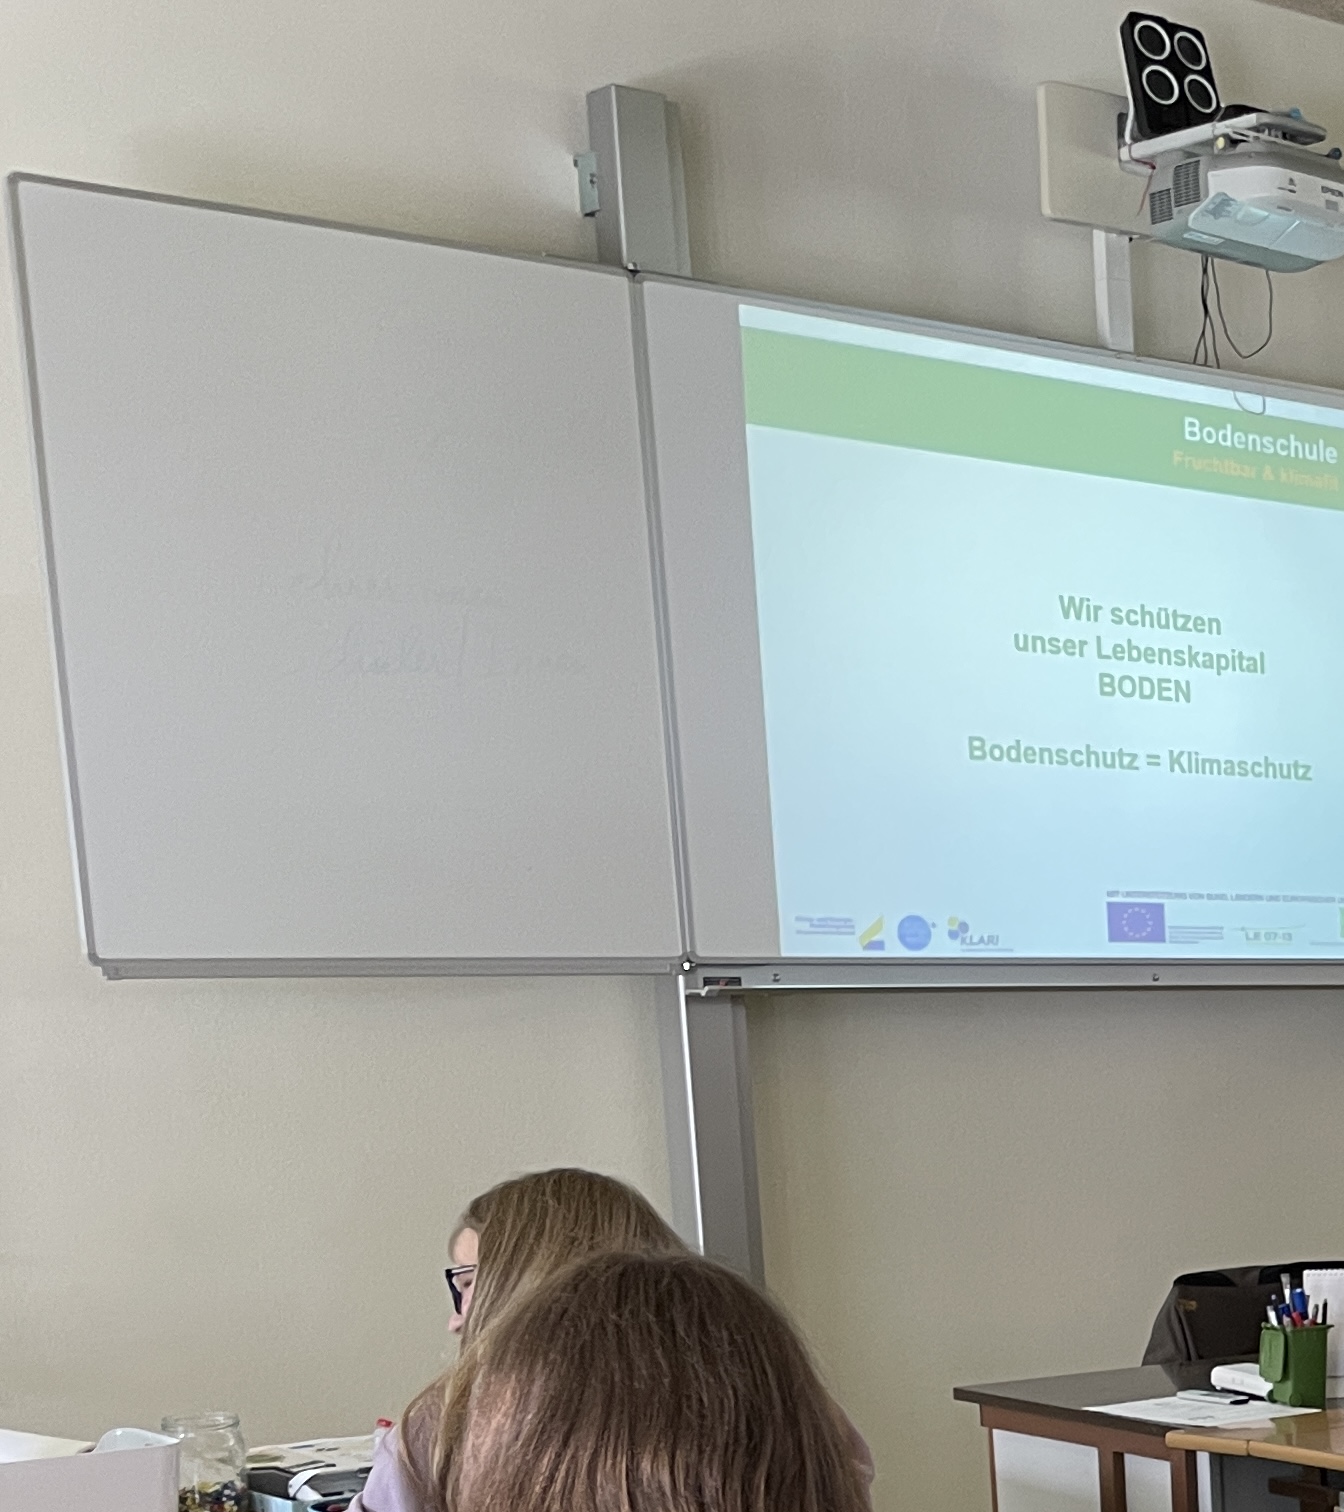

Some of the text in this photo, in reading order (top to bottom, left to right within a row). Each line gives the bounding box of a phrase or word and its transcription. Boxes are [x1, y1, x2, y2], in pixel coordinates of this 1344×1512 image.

[1184, 416, 1338, 464] Bodenschule
[1058, 594, 1222, 636] Wir schützen
[1013, 632, 1266, 676] unser Lebenskapital
[1098, 672, 1192, 704] BODEN
[967, 735, 1313, 782] Bodenschutz = Klimaschutz
